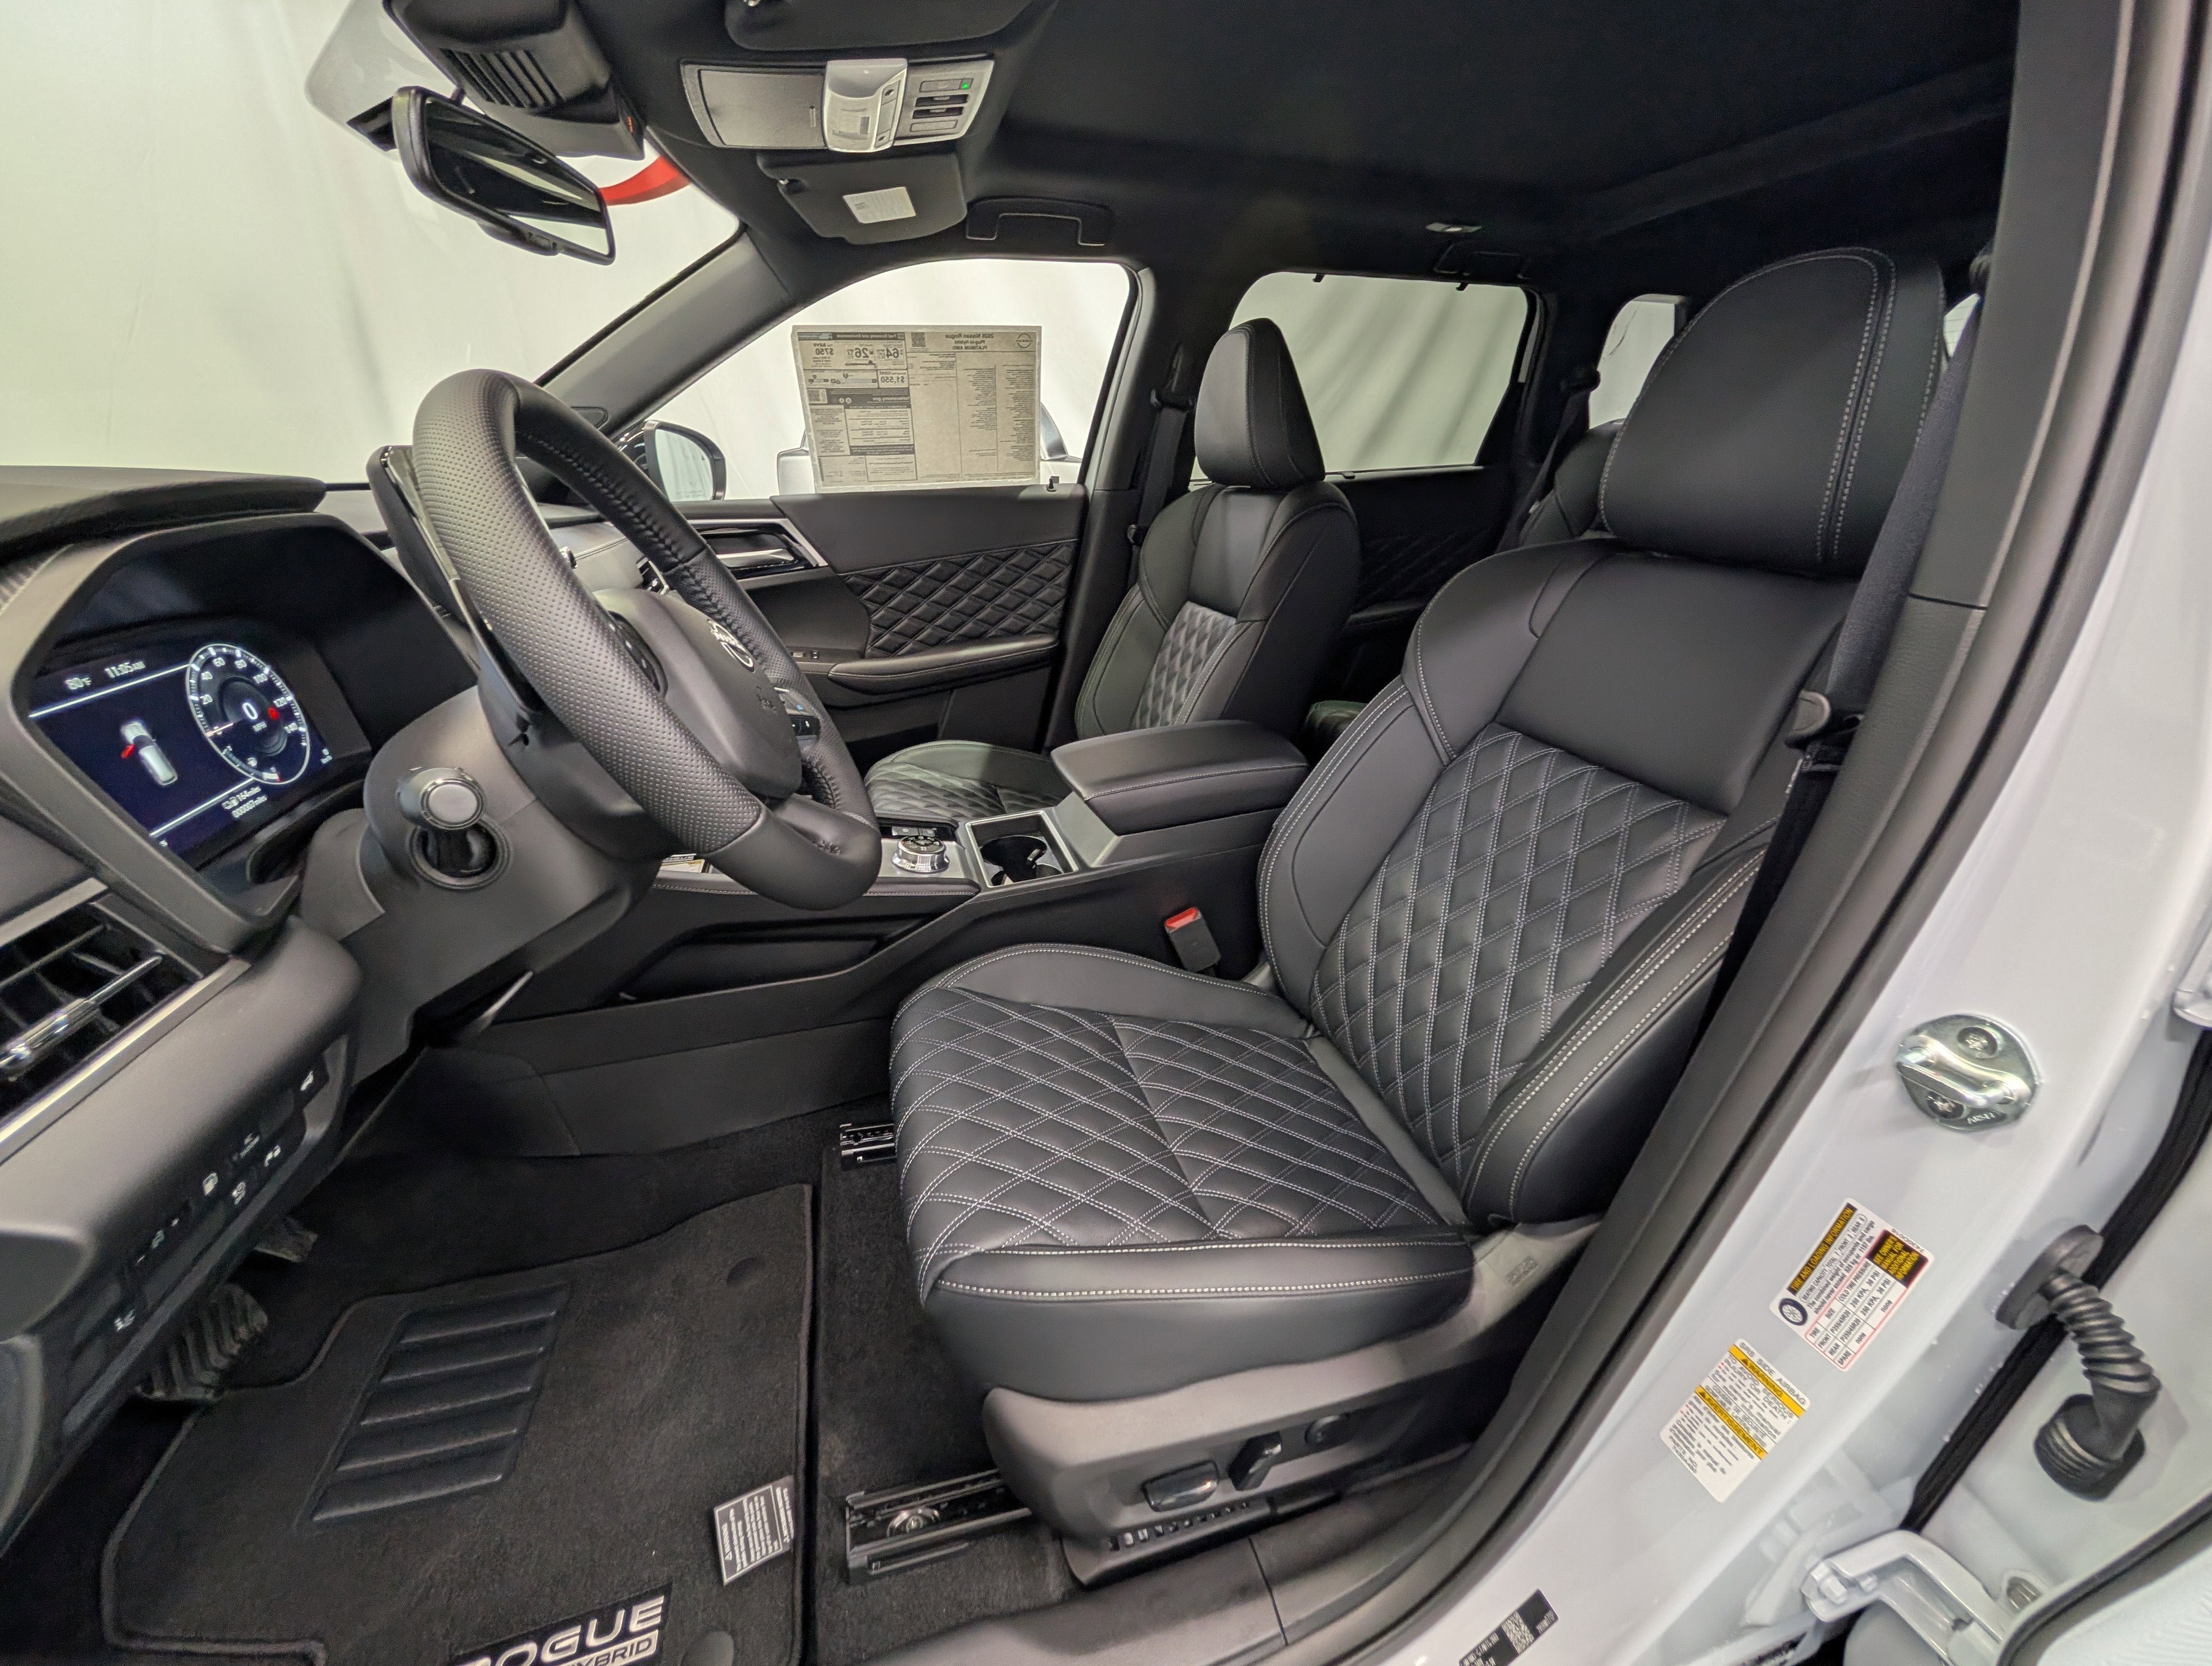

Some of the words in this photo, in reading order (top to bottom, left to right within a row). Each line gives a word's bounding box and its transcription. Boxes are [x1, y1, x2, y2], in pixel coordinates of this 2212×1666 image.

[213, 657, 226, 667] 60
[234, 659, 247, 669] 80
[200, 694, 213, 704] 20
[242, 702, 258, 720] 0
[1790, 1276, 1804, 1292] TIRE
[1798, 1264, 1813, 1280] AND
[1806, 1241, 1829, 1268] LOADING
[1823, 1206, 1854, 1245] INFORMATION
[1812, 1266, 1828, 1287] CAPACITY
[1825, 1255, 1837, 1268] TOTAL
[1837, 1236, 1850, 1252] FRONT
[1850, 1220, 1862, 1233] REAR
[1879, 1249, 1898, 1270] MANUAL
[1891, 1240, 1905, 1254] FOR
[1886, 1248, 1910, 1276] ADDITIONAL
[1806, 1298, 1816, 1310] The
[1812, 1279, 1831, 1302] combined
[1827, 1265, 1843, 1283] weight
[1855, 1231, 1867, 1242] and
[1893, 1250, 1921, 1281] INFORMATION
[1812, 1298, 1827, 1315] should
[1824, 1287, 1836, 1301] never
[1831, 1272, 1847, 1290] exceed
[1837, 1288, 1850, 1303] COLD
[1817, 1332, 1832, 1350] FRONT
[1827, 1341, 1841, 1357] REAR
[1738, 1341, 1756, 1359] SRS
[1756, 1357, 1777, 1377] SIDE
[1774, 1376, 1808, 1406] AIRBAG
[1747, 1362, 1785, 1398] WARNING
[1738, 1365, 1760, 1386] AVOID
[1760, 1387, 1796, 1419] SERIOUS
[1761, 1395, 1788, 1420] DEATH
[1703, 1396, 1765, 1457] AVERTISSEMENT
[456, 1595, 664, 1666] OGUE
[571, 1637, 652, 1666] YBRID
